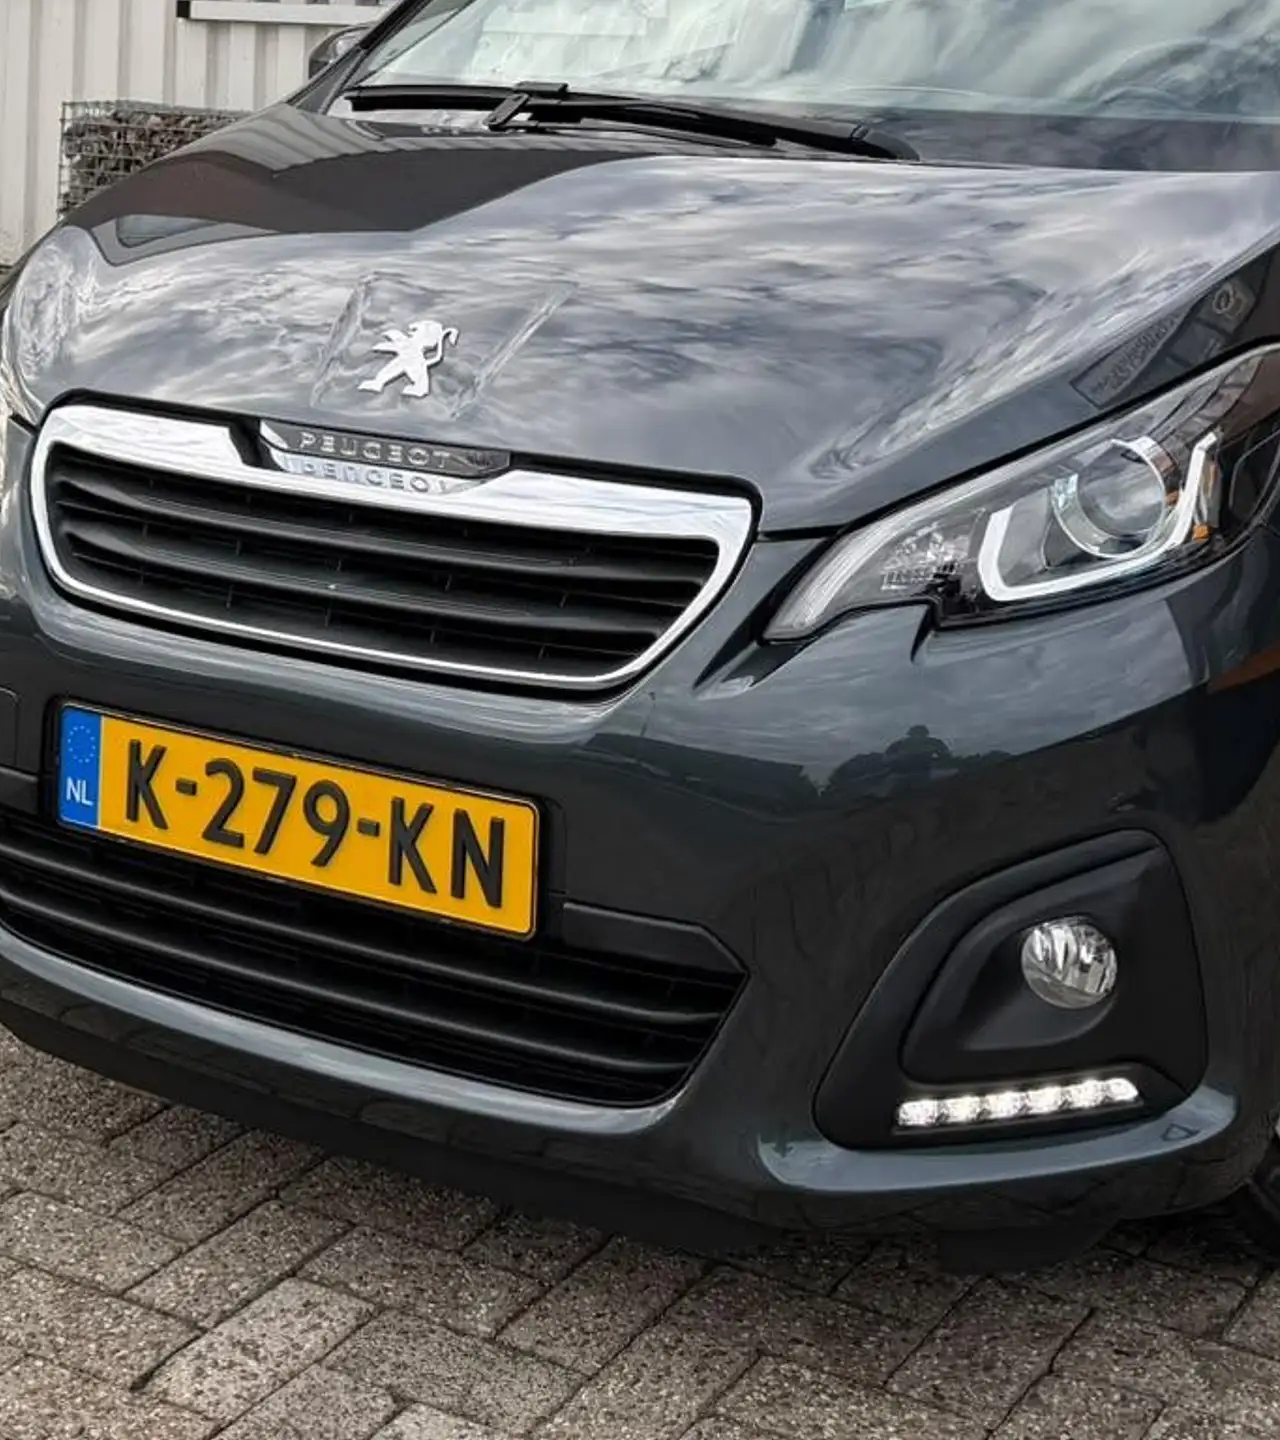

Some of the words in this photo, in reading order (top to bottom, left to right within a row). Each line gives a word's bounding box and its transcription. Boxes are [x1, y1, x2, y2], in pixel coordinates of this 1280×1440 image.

[298, 431, 452, 470] PEUGEOT
[66, 776, 93, 807] NL
[125, 738, 507, 910] K-279-KN
